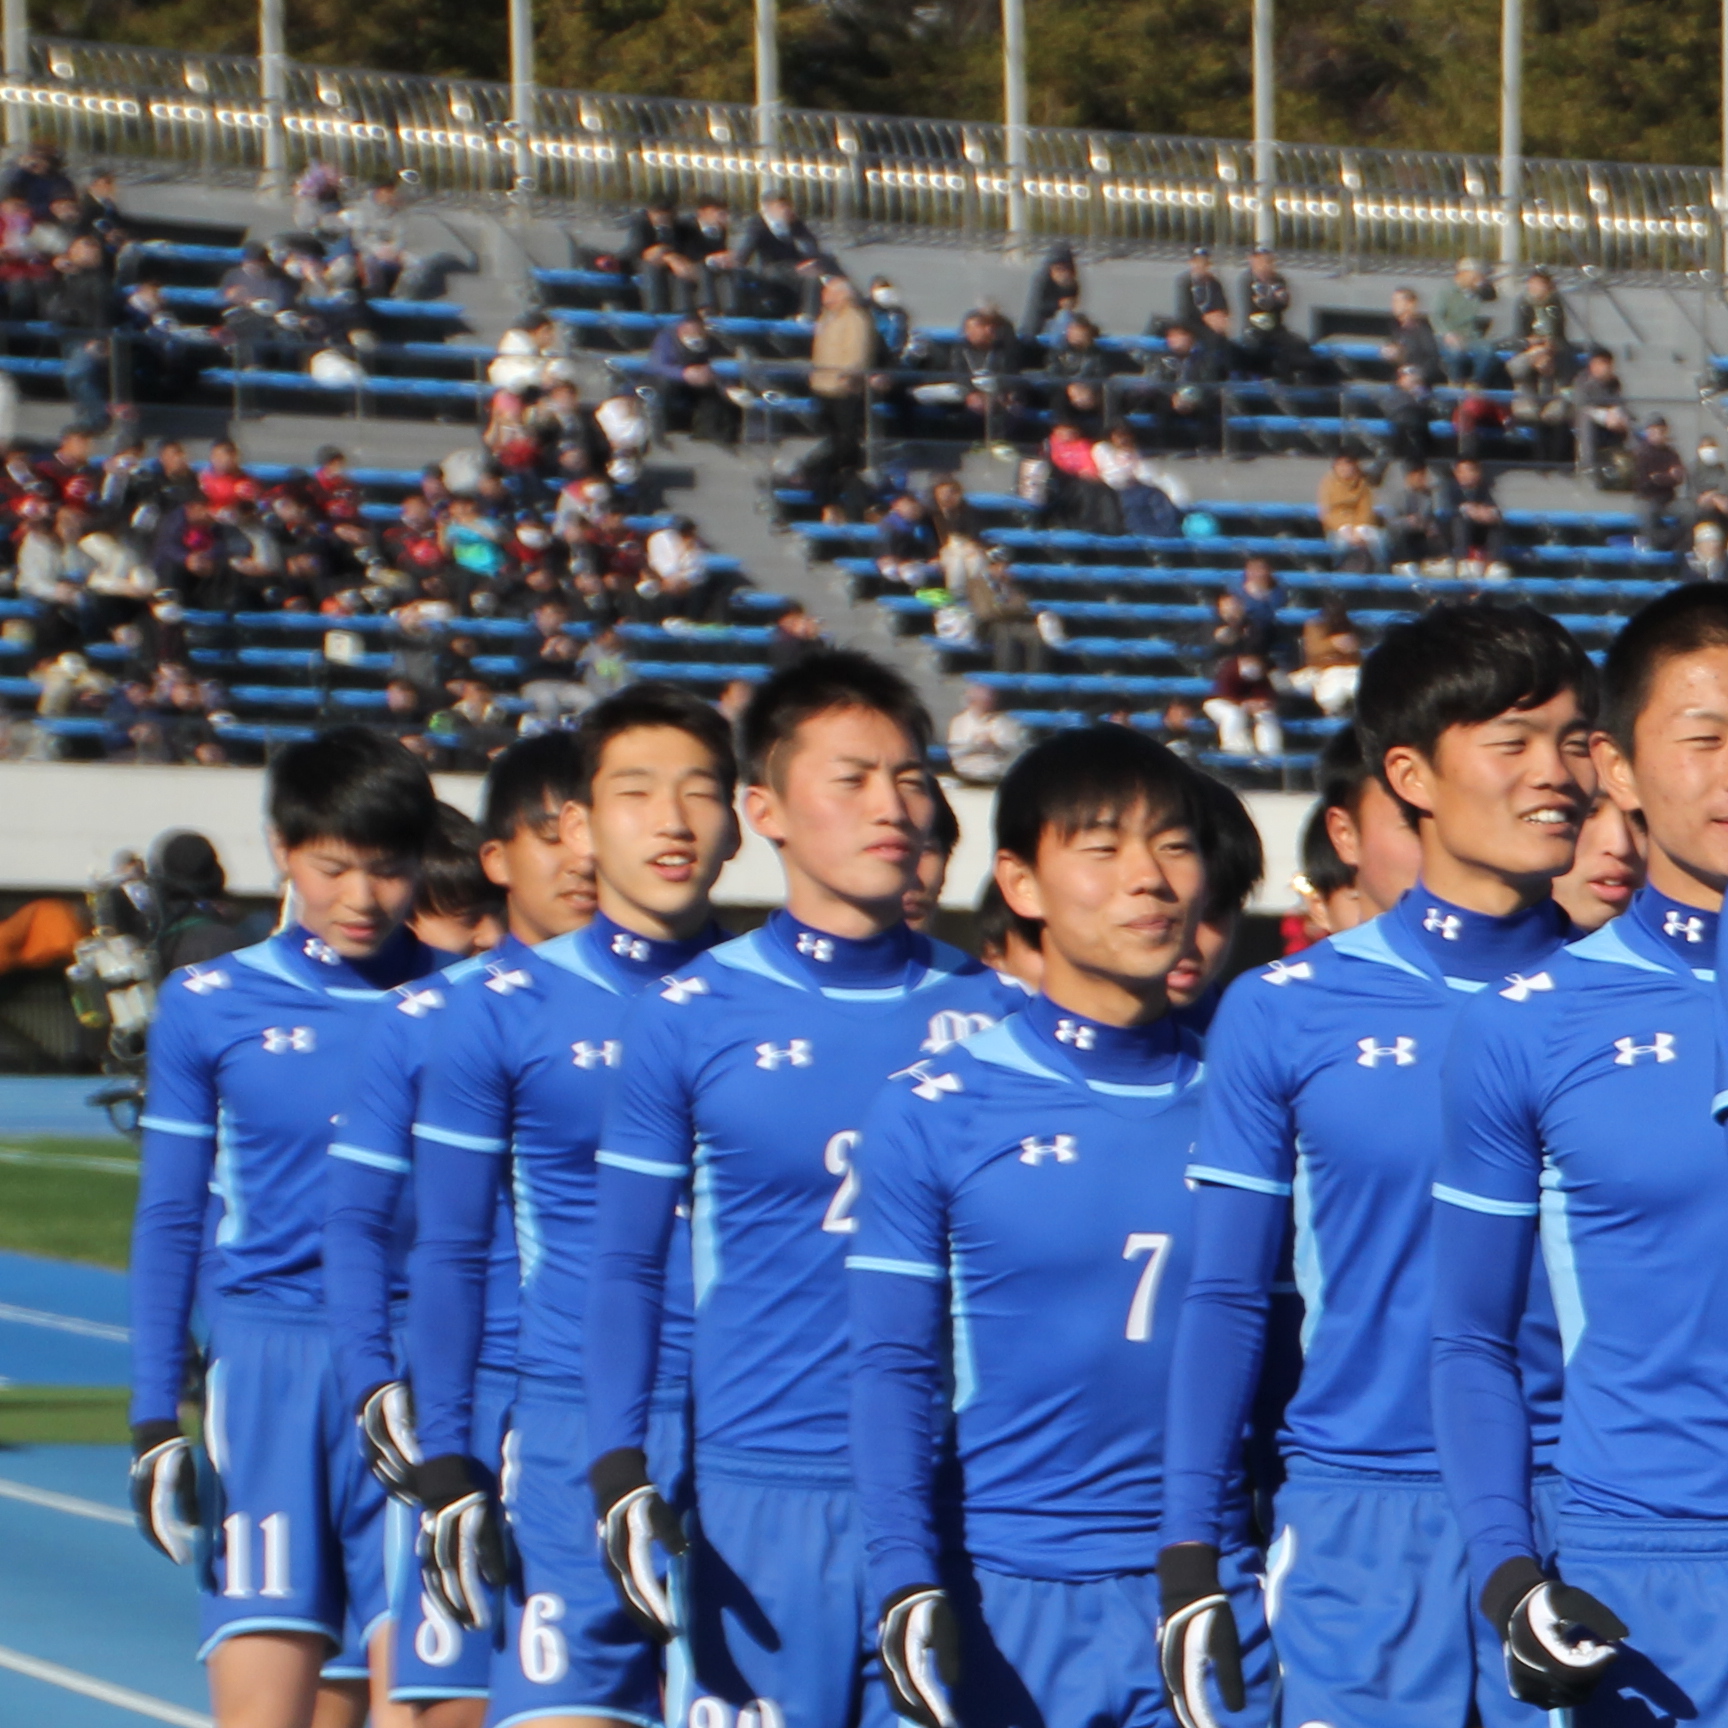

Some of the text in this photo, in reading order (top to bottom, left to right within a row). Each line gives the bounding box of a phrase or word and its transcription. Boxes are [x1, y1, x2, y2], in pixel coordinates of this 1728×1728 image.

[1121, 1233, 1171, 1342] 7
[222, 1512, 291, 1598] 11
[518, 1592, 567, 1684] 6
